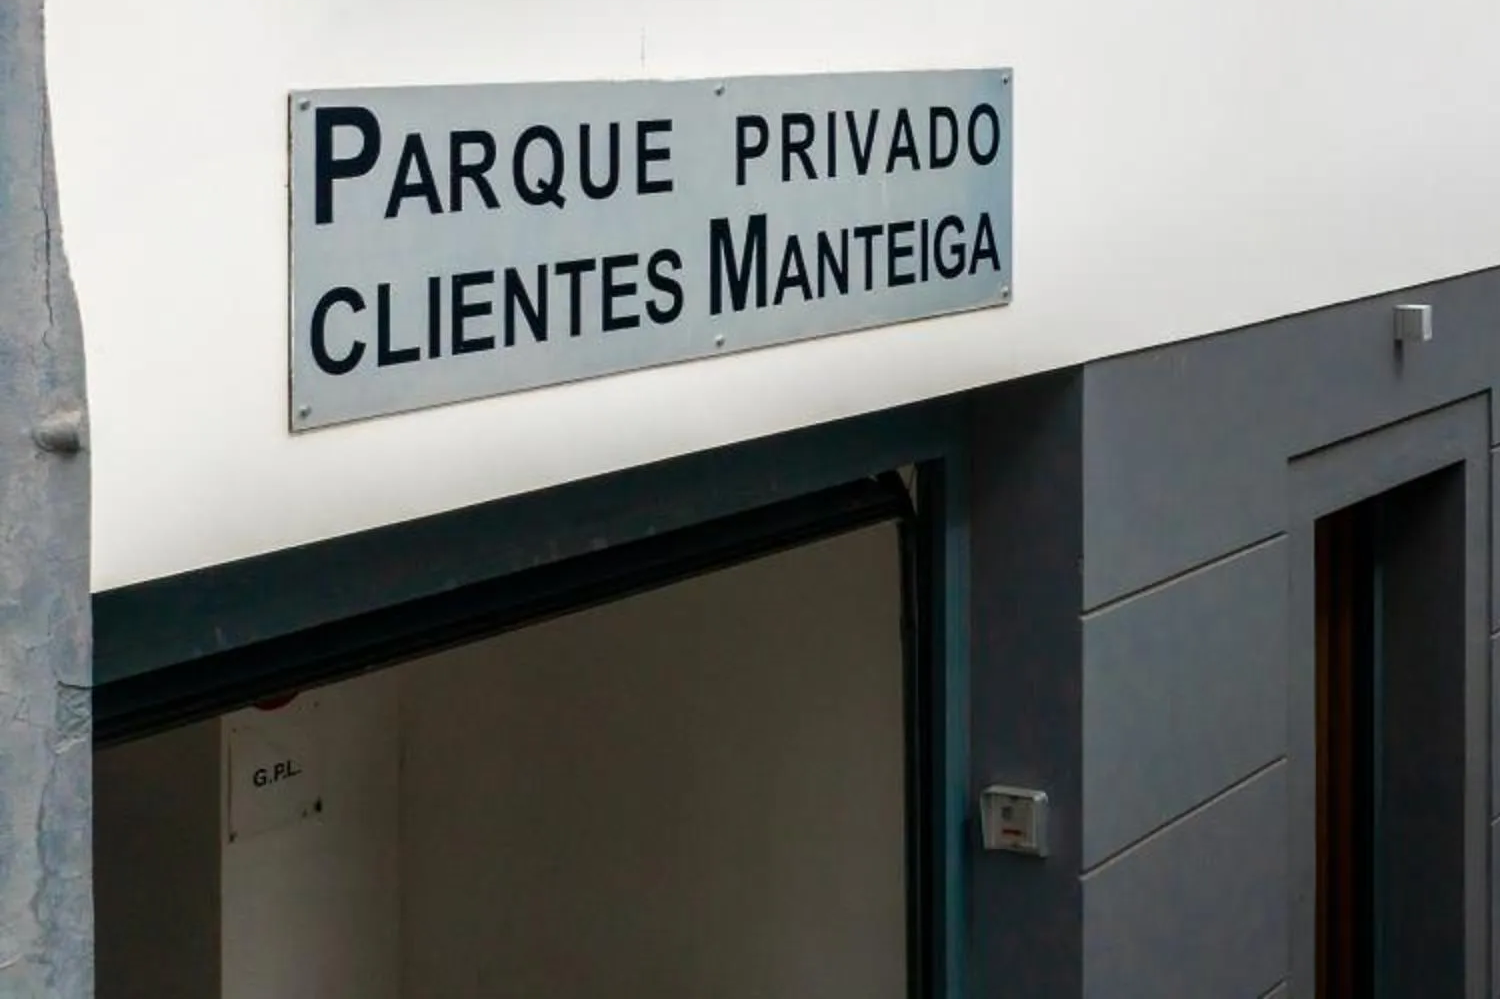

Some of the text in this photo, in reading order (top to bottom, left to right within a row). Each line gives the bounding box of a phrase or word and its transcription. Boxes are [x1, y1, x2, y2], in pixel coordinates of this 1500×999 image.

[315, 102, 1001, 225] PARQUE PRIVADO
[310, 212, 1001, 376] CLIENTES MANTEIGA
